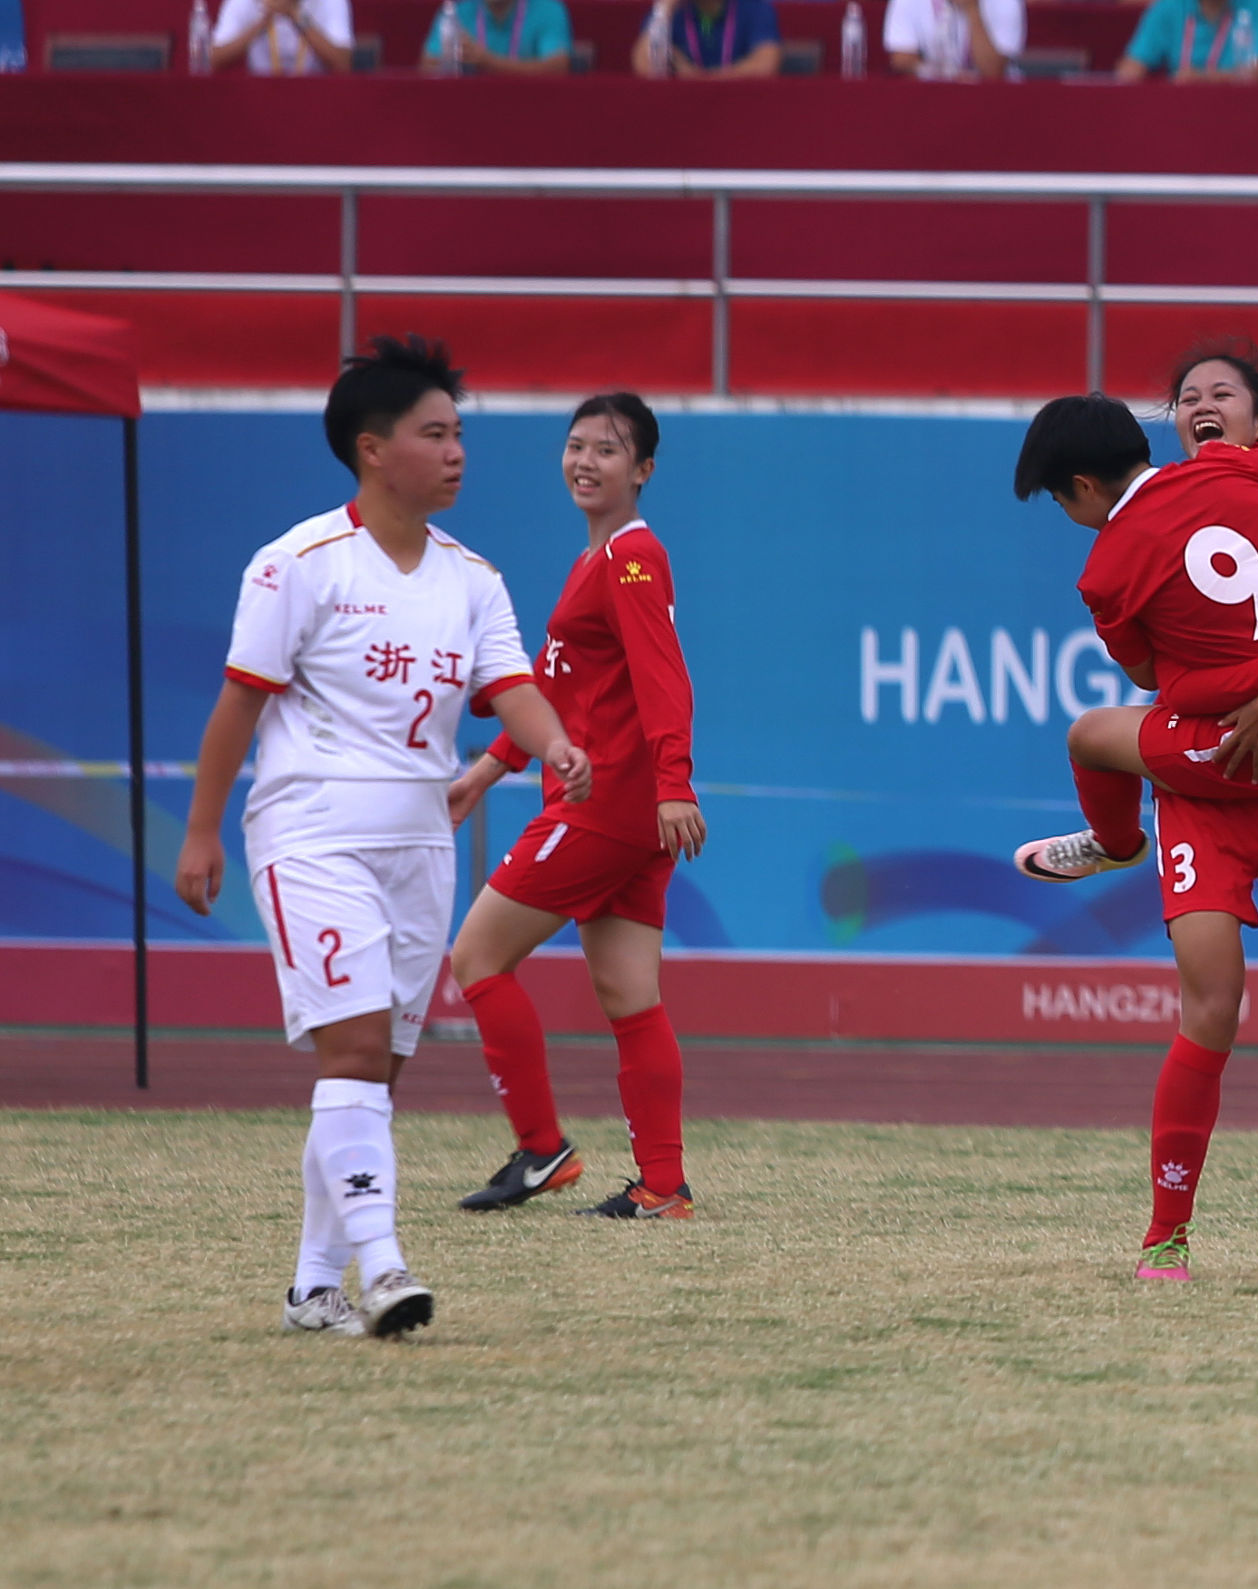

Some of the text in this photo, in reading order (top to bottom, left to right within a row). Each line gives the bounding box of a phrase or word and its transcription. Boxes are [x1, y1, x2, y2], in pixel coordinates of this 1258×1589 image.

[334, 603, 388, 616] KELME
[364, 641, 465, 690] 浙江
[860, 625, 1160, 725] HANG
[407, 689, 434, 749] 2
[1170, 842, 1197, 894] 3
[318, 926, 352, 988] 2
